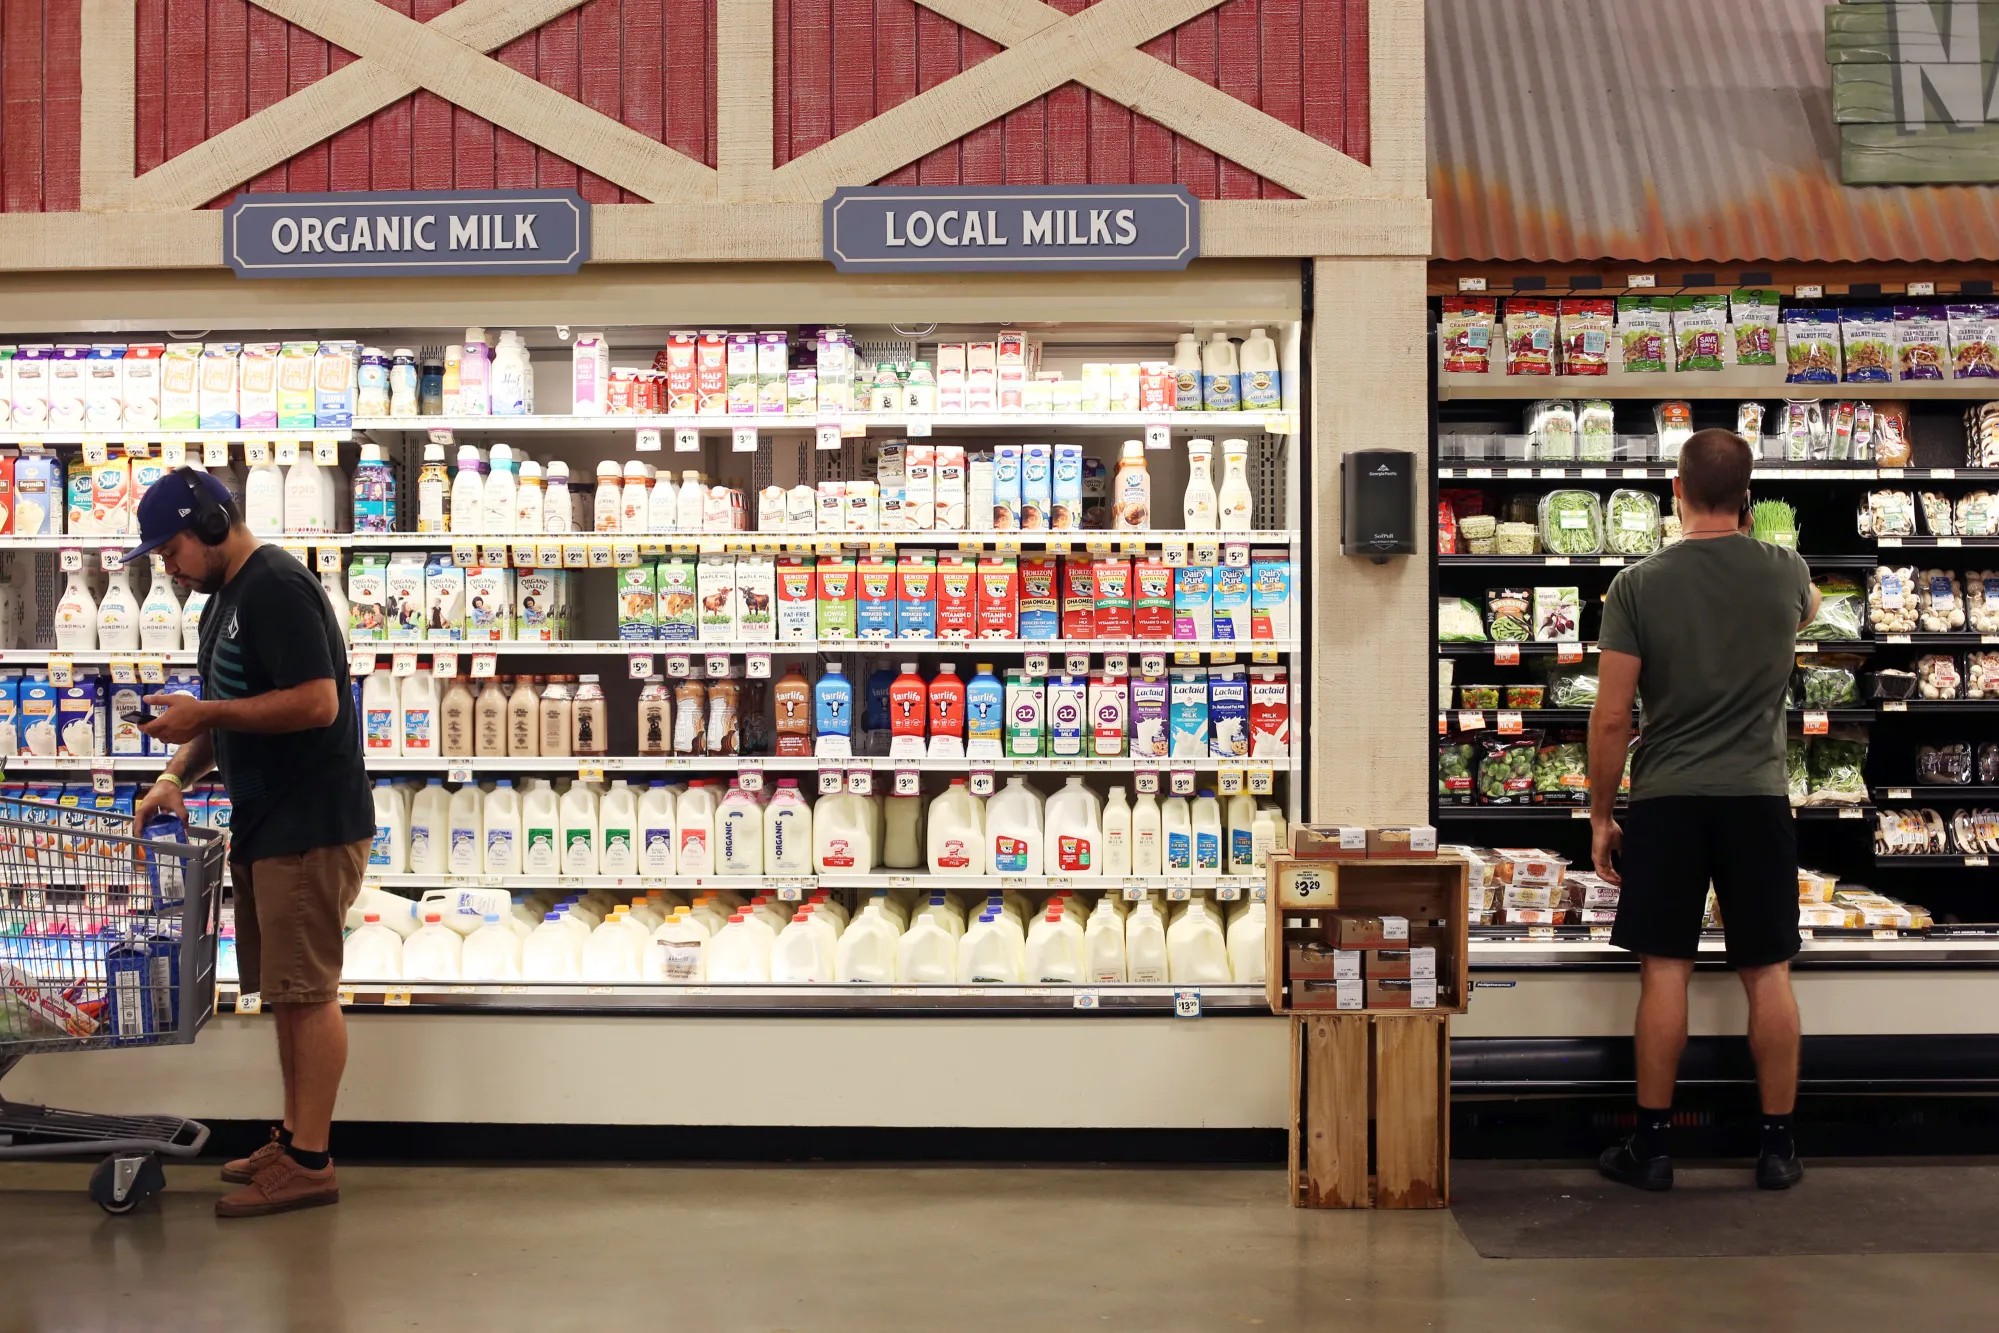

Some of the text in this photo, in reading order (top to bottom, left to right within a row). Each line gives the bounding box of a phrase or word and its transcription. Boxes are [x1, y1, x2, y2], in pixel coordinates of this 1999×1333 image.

[885, 208, 1138, 247] LOCAL MILKS
[271, 213, 539, 253] ORGANIC MILK
[997, 466, 1016, 481] Silk
[1025, 466, 1046, 481] Silk
[1056, 466, 1078, 481] Silk
[99, 472, 120, 488] Silk
[1183, 570, 1206, 578] Dairy
[1221, 570, 1244, 578] Dairy
[1259, 570, 1282, 578] Dairy
[352, 578, 380, 587] ORGANIC
[390, 578, 419, 587] ORGANIC
[430, 579, 458, 587] ORGANIC
[467, 579, 497, 587] ORGANIC
[521, 579, 549, 587] ORGANIC
[1223, 577, 1241, 585] Pure
[1174, 686, 1205, 694] Lactaid
[1214, 688, 1242, 696] Lactaid
[1254, 686, 1284, 695] Lactaid
[776, 691, 804, 701] fairlife
[821, 691, 849, 701] fairlife
[892, 691, 920, 702] fairlife
[929, 691, 957, 702] fairlife
[969, 691, 997, 703] fairlife
[1018, 708, 1032, 719] a2
[1060, 709, 1074, 719] a2
[1102, 709, 1115, 719] a2
